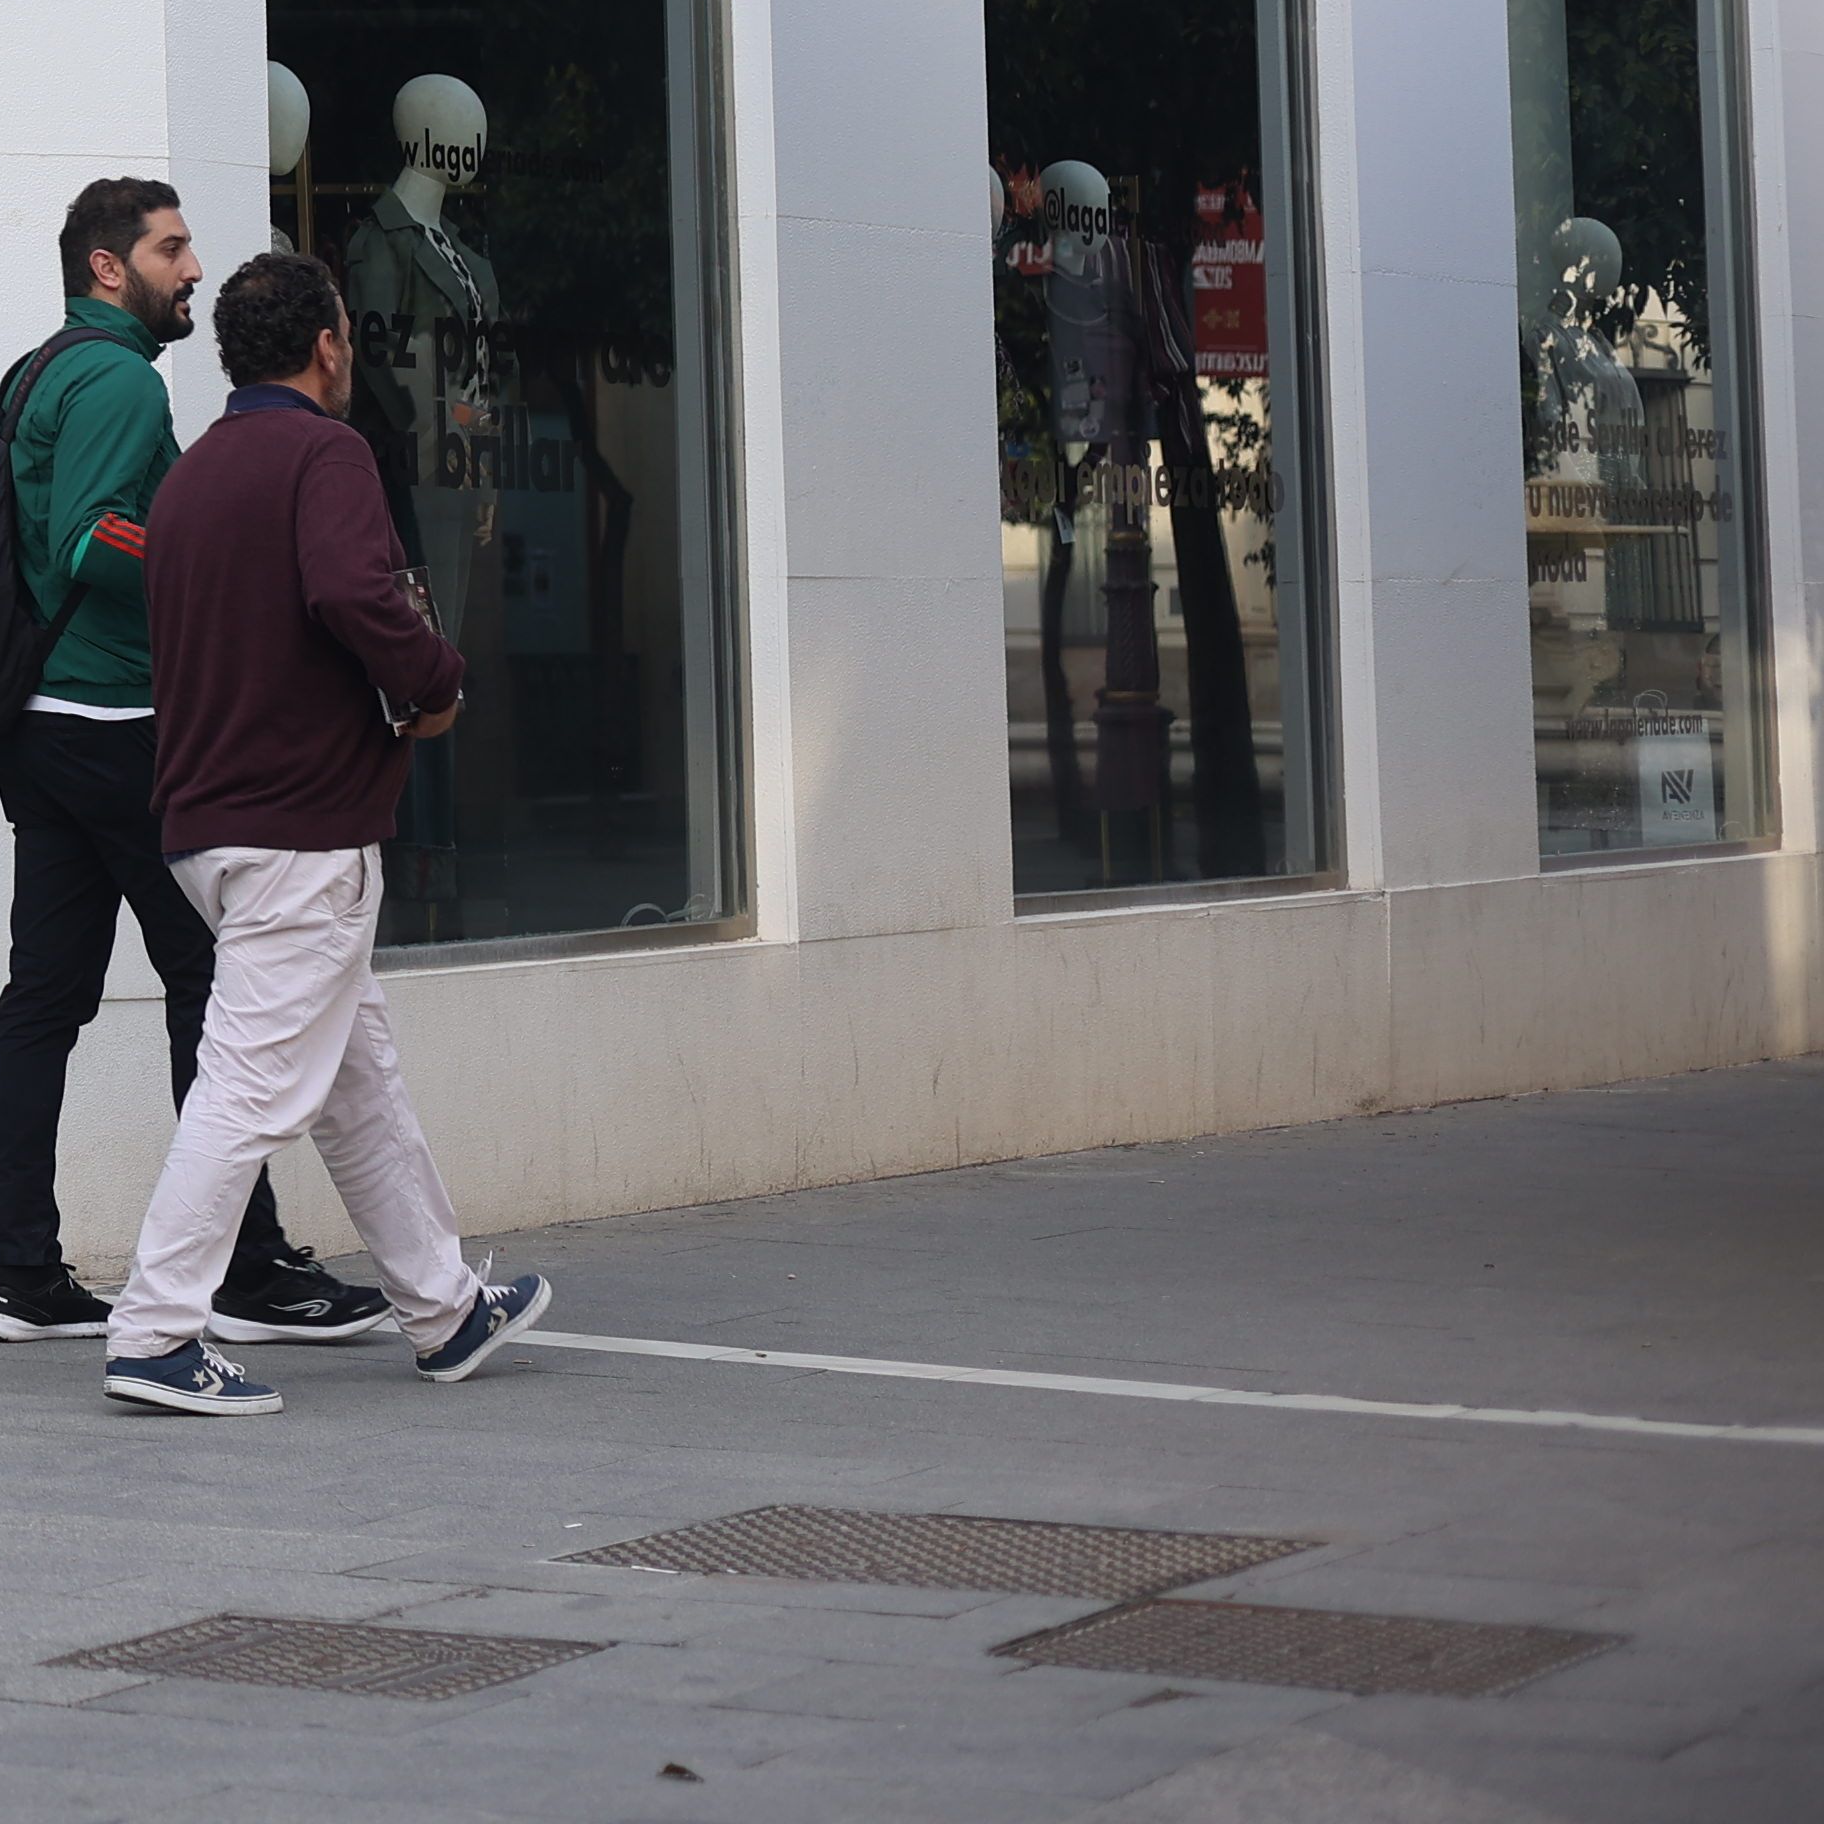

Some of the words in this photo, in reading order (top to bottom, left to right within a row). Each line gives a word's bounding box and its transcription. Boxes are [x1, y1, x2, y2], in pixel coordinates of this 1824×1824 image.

[436, 399, 583, 491] brillar
[1674, 414, 1728, 461] Jerez
[1076, 440, 1209, 525] empieza
[1216, 457, 1286, 514] todo
[1548, 484, 1610, 519] nuevo
[1710, 474, 1733, 522] de
